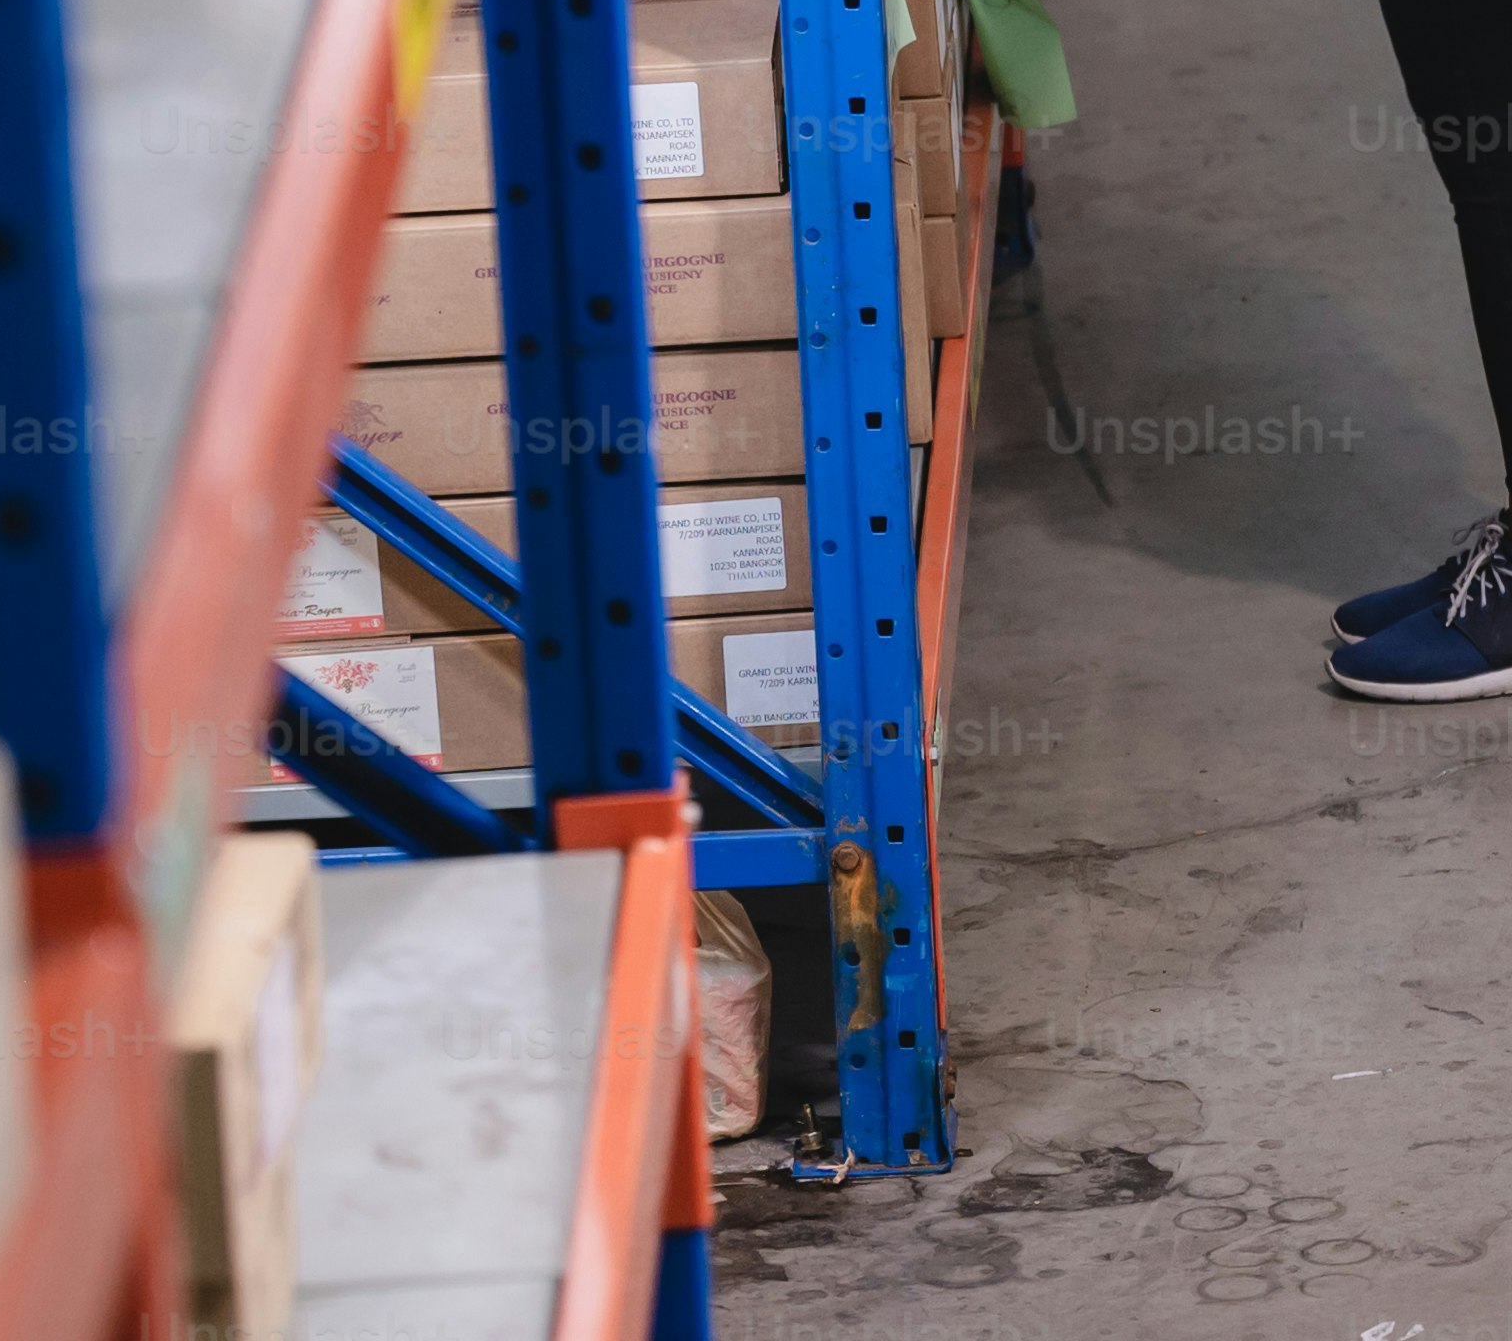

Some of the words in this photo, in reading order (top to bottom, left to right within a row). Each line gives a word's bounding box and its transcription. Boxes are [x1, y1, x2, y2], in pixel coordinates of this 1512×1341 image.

[676, 117, 694, 127] LTD
[669, 141, 696, 150] ROAD
[644, 165, 697, 175] THAILANDE
[658, 519, 691, 530] GRAND
[693, 517, 713, 527] CRU
[715, 515, 741, 525] WINE
[762, 512, 781, 522] LTD
[679, 529, 705, 540] 7/209
[707, 524, 781, 537] KARNJANAPISEK
[755, 536, 783, 545] ROAD
[732, 546, 783, 558] KANNAYAO
[710, 561, 737, 572] 10230
[739, 558, 784, 569] BANGKOK
[738, 668, 771, 678] GRAND
[773, 666, 793, 676] CRU
[759, 679, 785, 689] 7/209
[764, 711, 808, 722] BANGKOK
